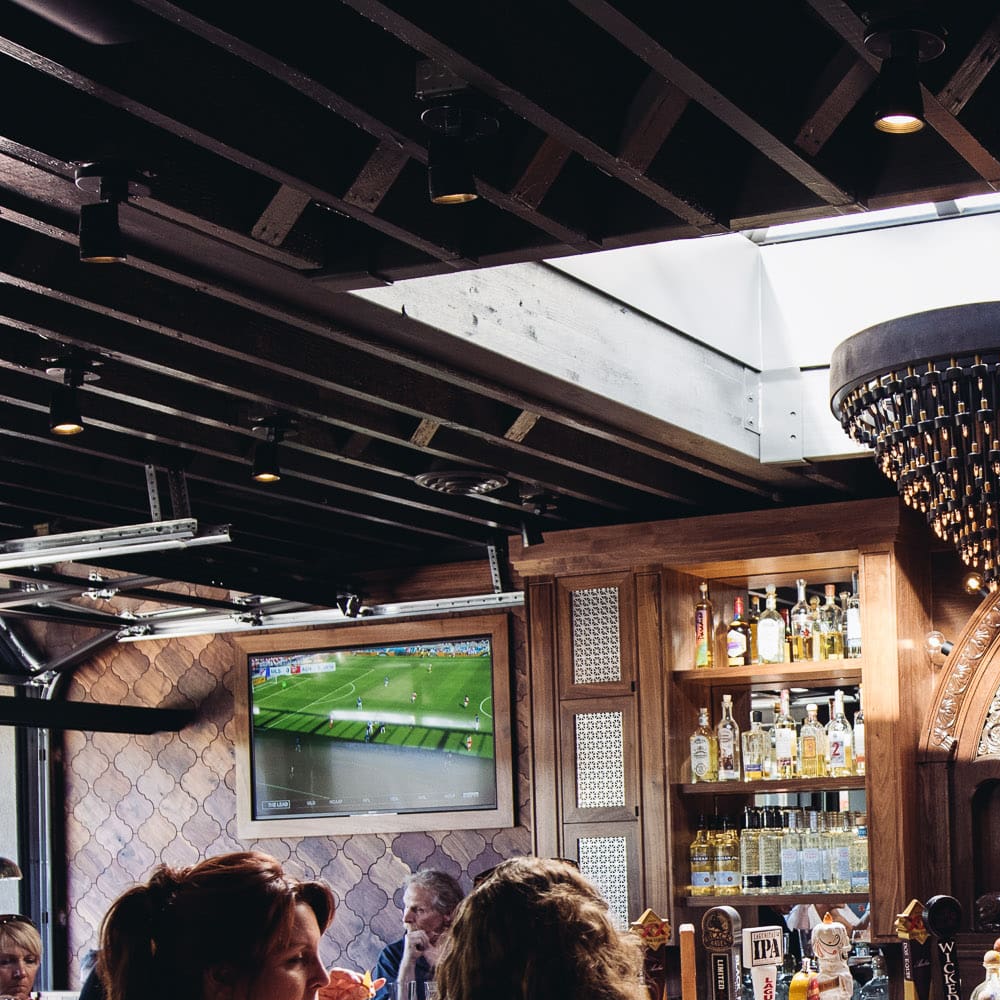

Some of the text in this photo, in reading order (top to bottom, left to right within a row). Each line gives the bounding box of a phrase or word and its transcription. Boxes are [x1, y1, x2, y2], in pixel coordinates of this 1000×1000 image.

[831, 741, 841, 756] 2
[753, 938, 780, 960] IPA
[717, 959, 725, 991] LIMITED
